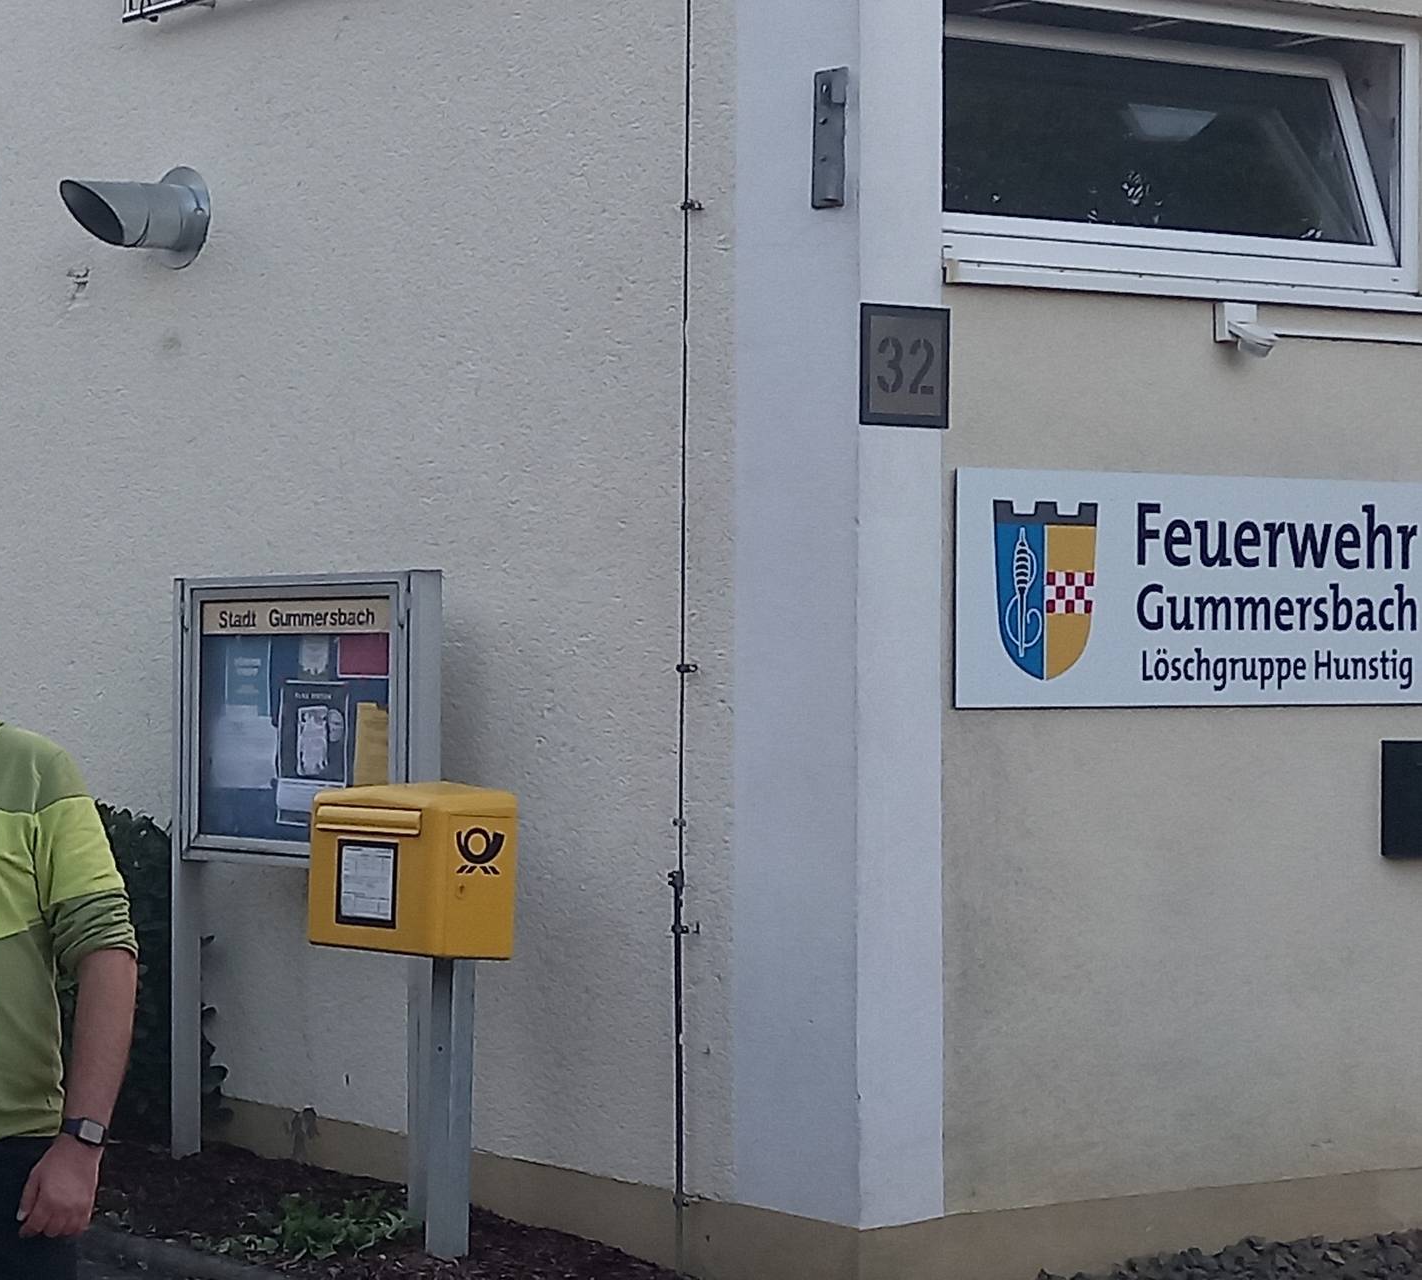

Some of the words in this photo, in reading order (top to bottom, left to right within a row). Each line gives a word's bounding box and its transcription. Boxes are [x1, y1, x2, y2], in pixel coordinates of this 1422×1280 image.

[877, 336, 935, 395] 32
[1136, 502, 1418, 570] Feuerwehr
[218, 609, 256, 628] Stadt
[268, 608, 375, 628] Gummersbach
[1136, 583, 1418, 632] Gummersbach
[1141, 648, 1306, 691] Löschgruppe
[1314, 649, 1414, 690] Hunstig
